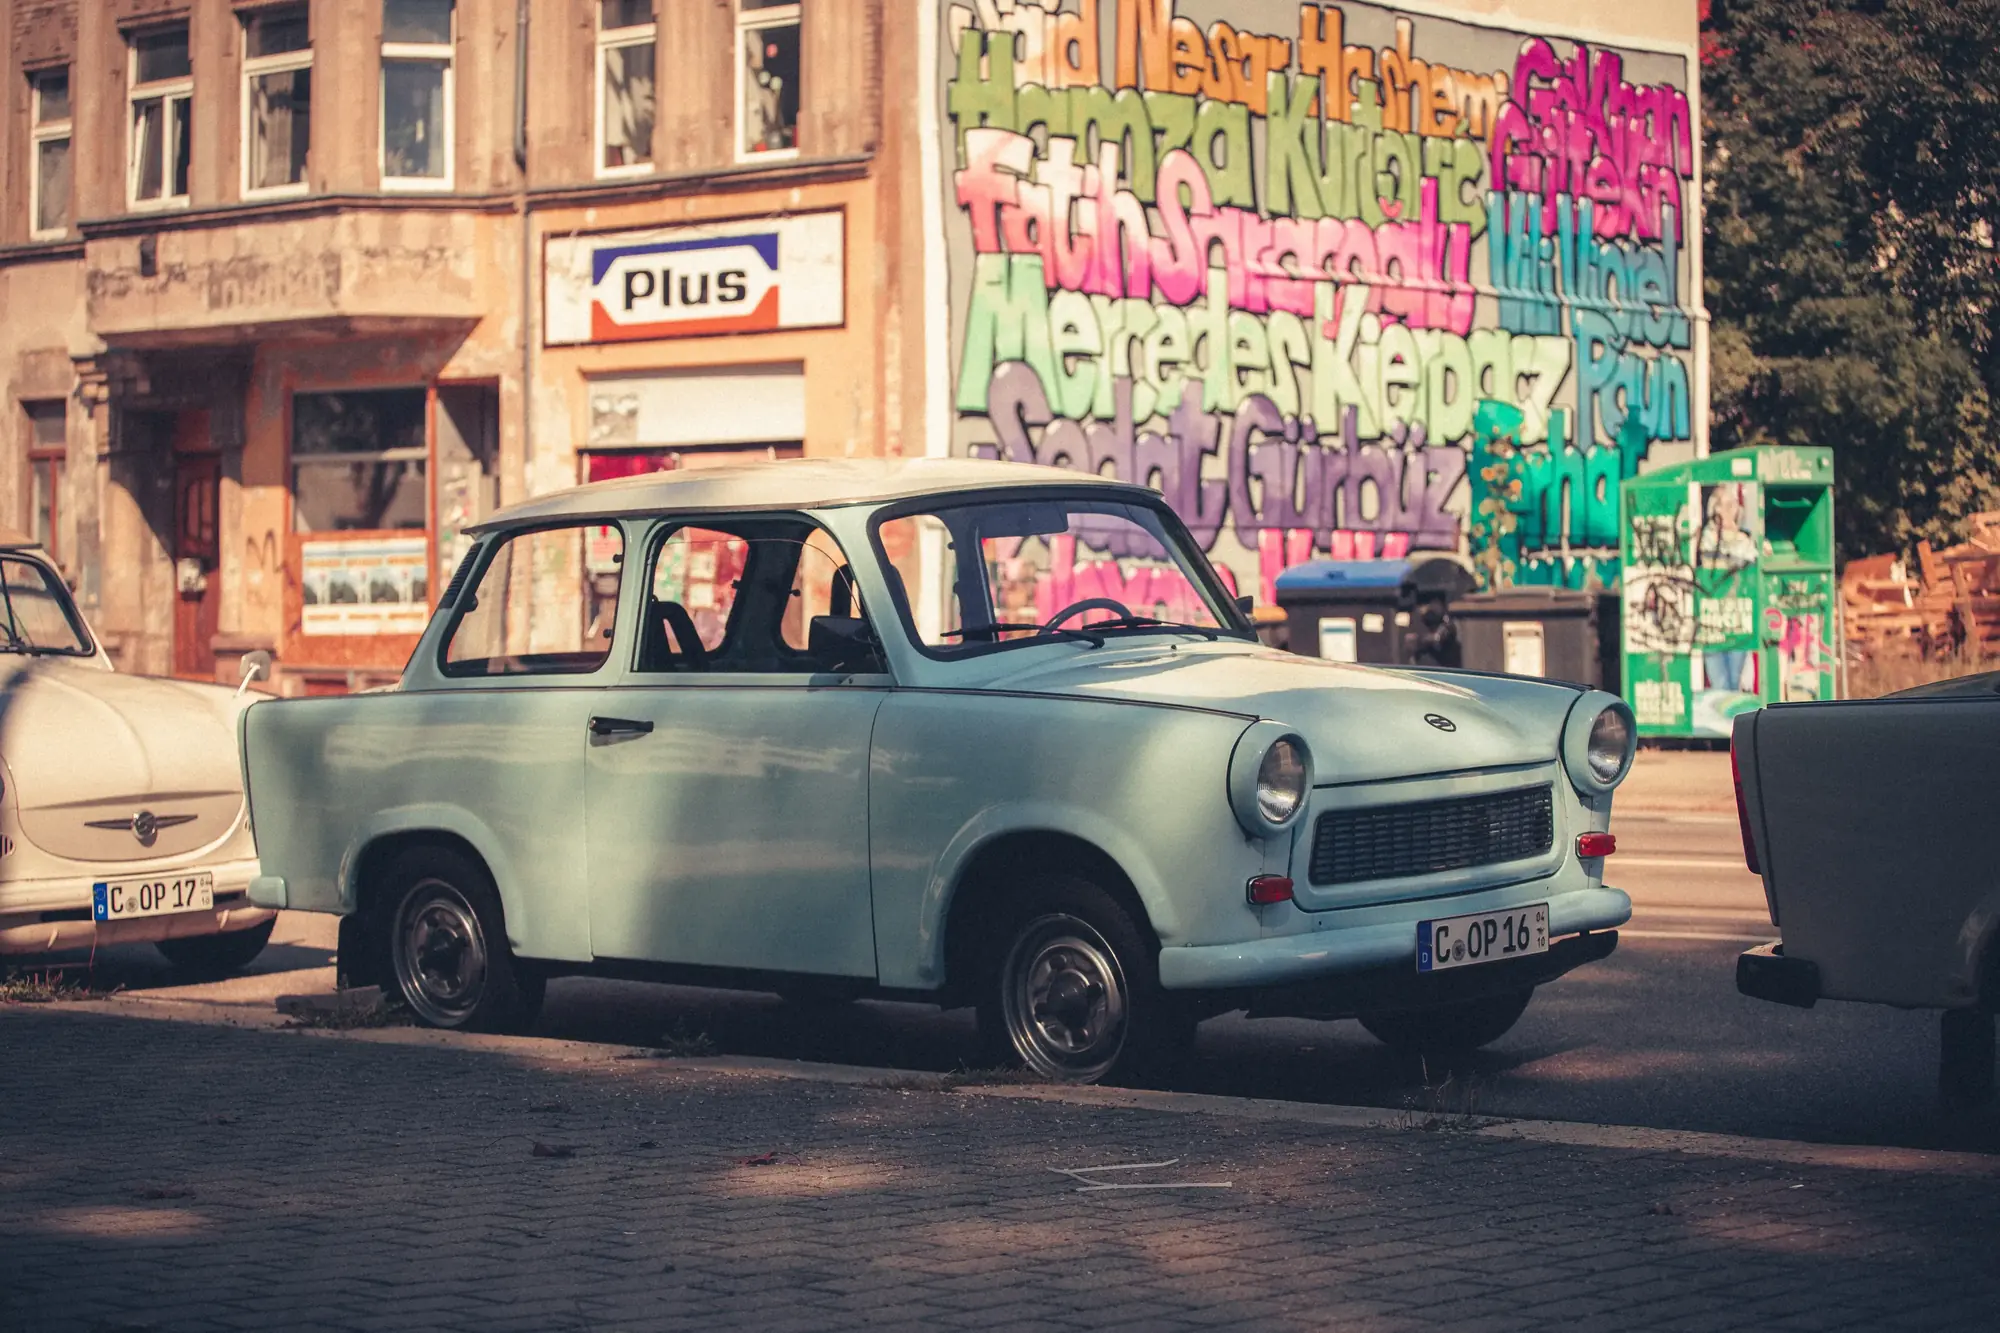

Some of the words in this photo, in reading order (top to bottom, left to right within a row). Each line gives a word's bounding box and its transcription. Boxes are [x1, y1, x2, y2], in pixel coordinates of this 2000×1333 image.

[1115, 0, 1292, 118] Nesar
[1298, 4, 1510, 152] Hashemi
[948, 28, 1256, 209] Hamza
[953, 126, 1151, 299] Fatih
[624, 269, 747, 310] Plus
[956, 252, 1314, 424] Mercedes
[1311, 280, 1575, 448] Kierpacz
[98, 904, 104, 914] D
[110, 885, 124, 914] C
[140, 882, 166, 911] OP
[172, 879, 196, 908] 17
[1536, 911, 1546, 923] 04
[1422, 952, 1428, 963] D
[1435, 925, 1451, 964] C
[1467, 918, 1498, 959] OP
[1502, 913, 1531, 954] 16
[1537, 936, 1546, 948] 10
